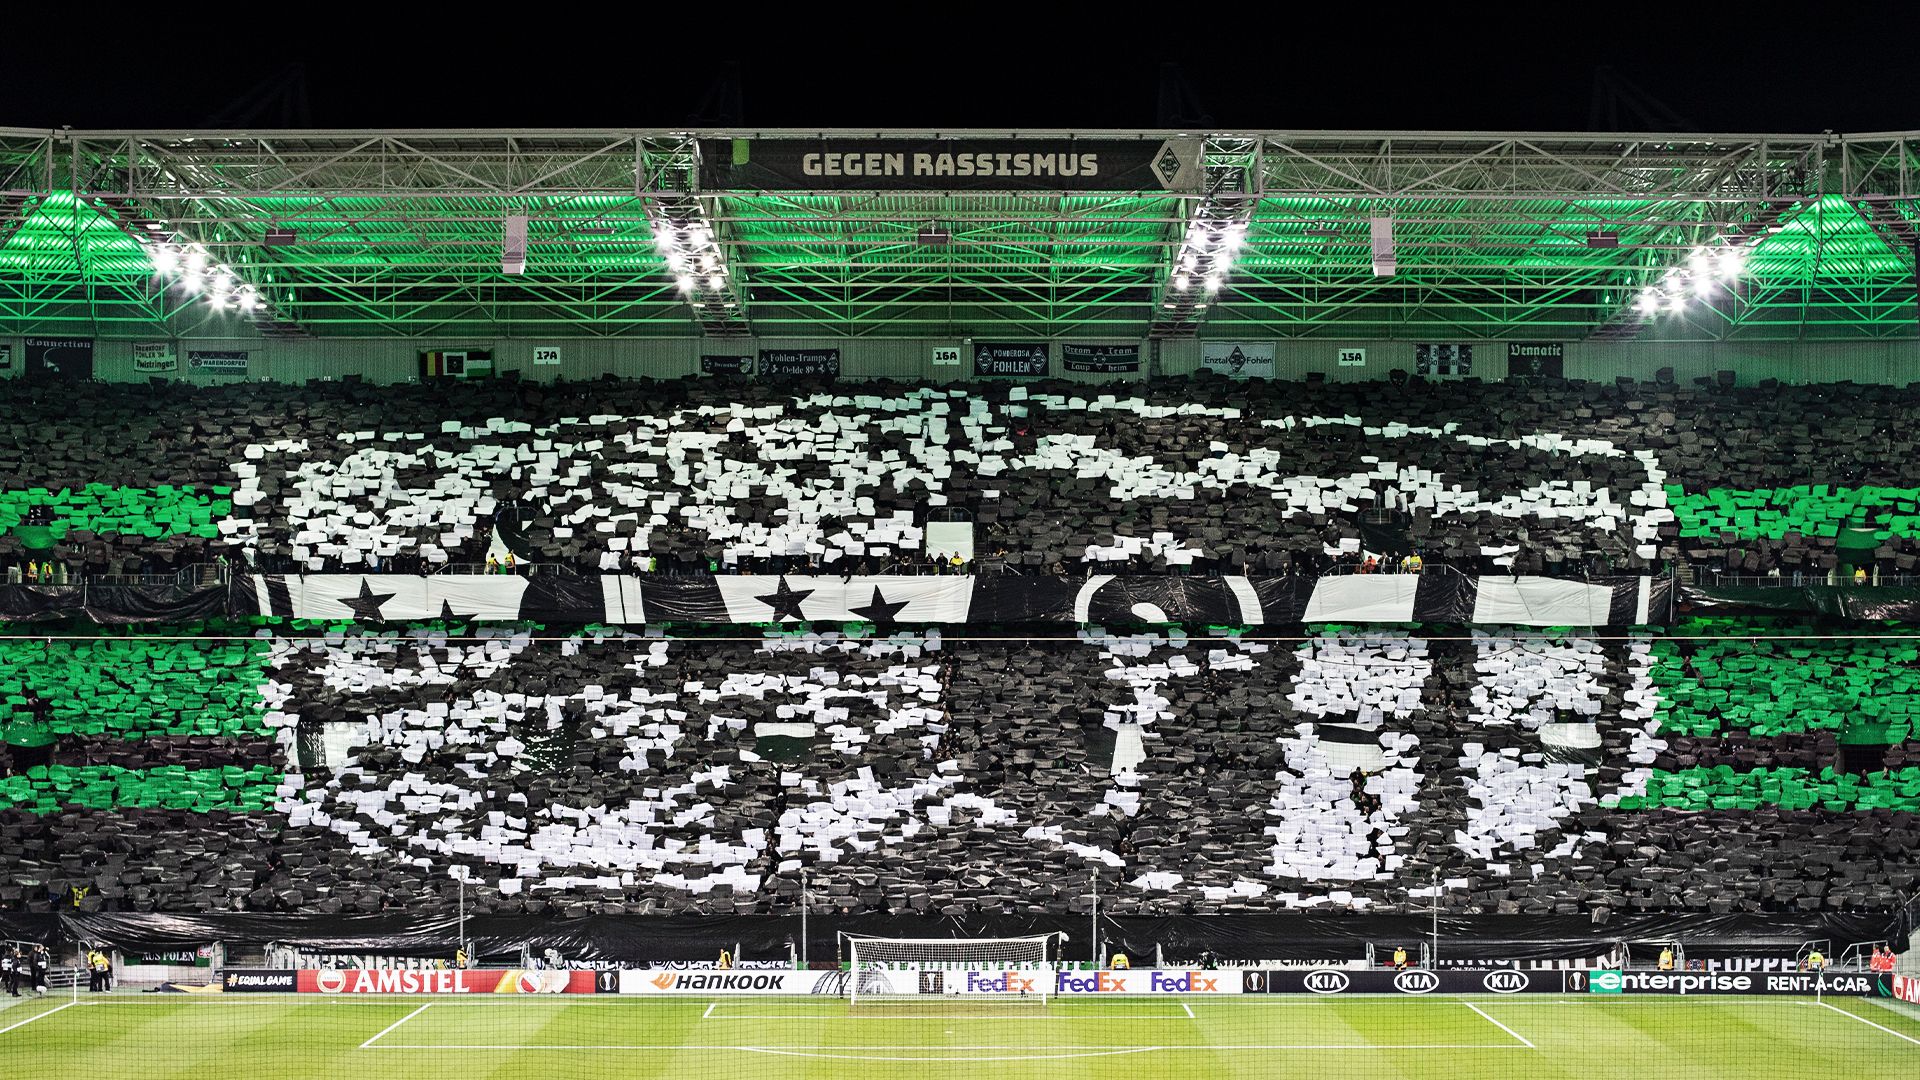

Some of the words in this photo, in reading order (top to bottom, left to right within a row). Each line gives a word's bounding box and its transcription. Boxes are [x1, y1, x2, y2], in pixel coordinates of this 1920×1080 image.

[803, 153, 905, 176] GEGEN
[913, 153, 1099, 177] RASSISMUS
[26, 338, 91, 348] Connection
[1510, 343, 1561, 356] Vennatic
[536, 351, 558, 360] 17A
[770, 353, 827, 364] Fohlen-Tramps
[935, 351, 958, 361] 16A
[993, 349, 1031, 358] PONDEROSA
[1204, 356, 1229, 364] Enztal
[1246, 356, 1272, 364] Fohlen
[1341, 352, 1363, 362] 15A
[782, 365, 804, 374] Oelde
[805, 365, 815, 374] 89
[993, 360, 1031, 373] FOHLEN
[142, 951, 161, 961] AUS
[162, 951, 195, 961] POLEN
[352, 969, 470, 992] AMSTEL
[967, 971, 1034, 992] FedEx
[1058, 971, 1127, 992] FedEx
[1151, 971, 1217, 992] FedEx
[1311, 974, 1342, 989] KIA
[1401, 974, 1432, 989] KIA
[1491, 974, 1522, 989] KIA
[1598, 972, 1751, 994] enterprise
[1767, 976, 1868, 992] RENT-A-CAR
